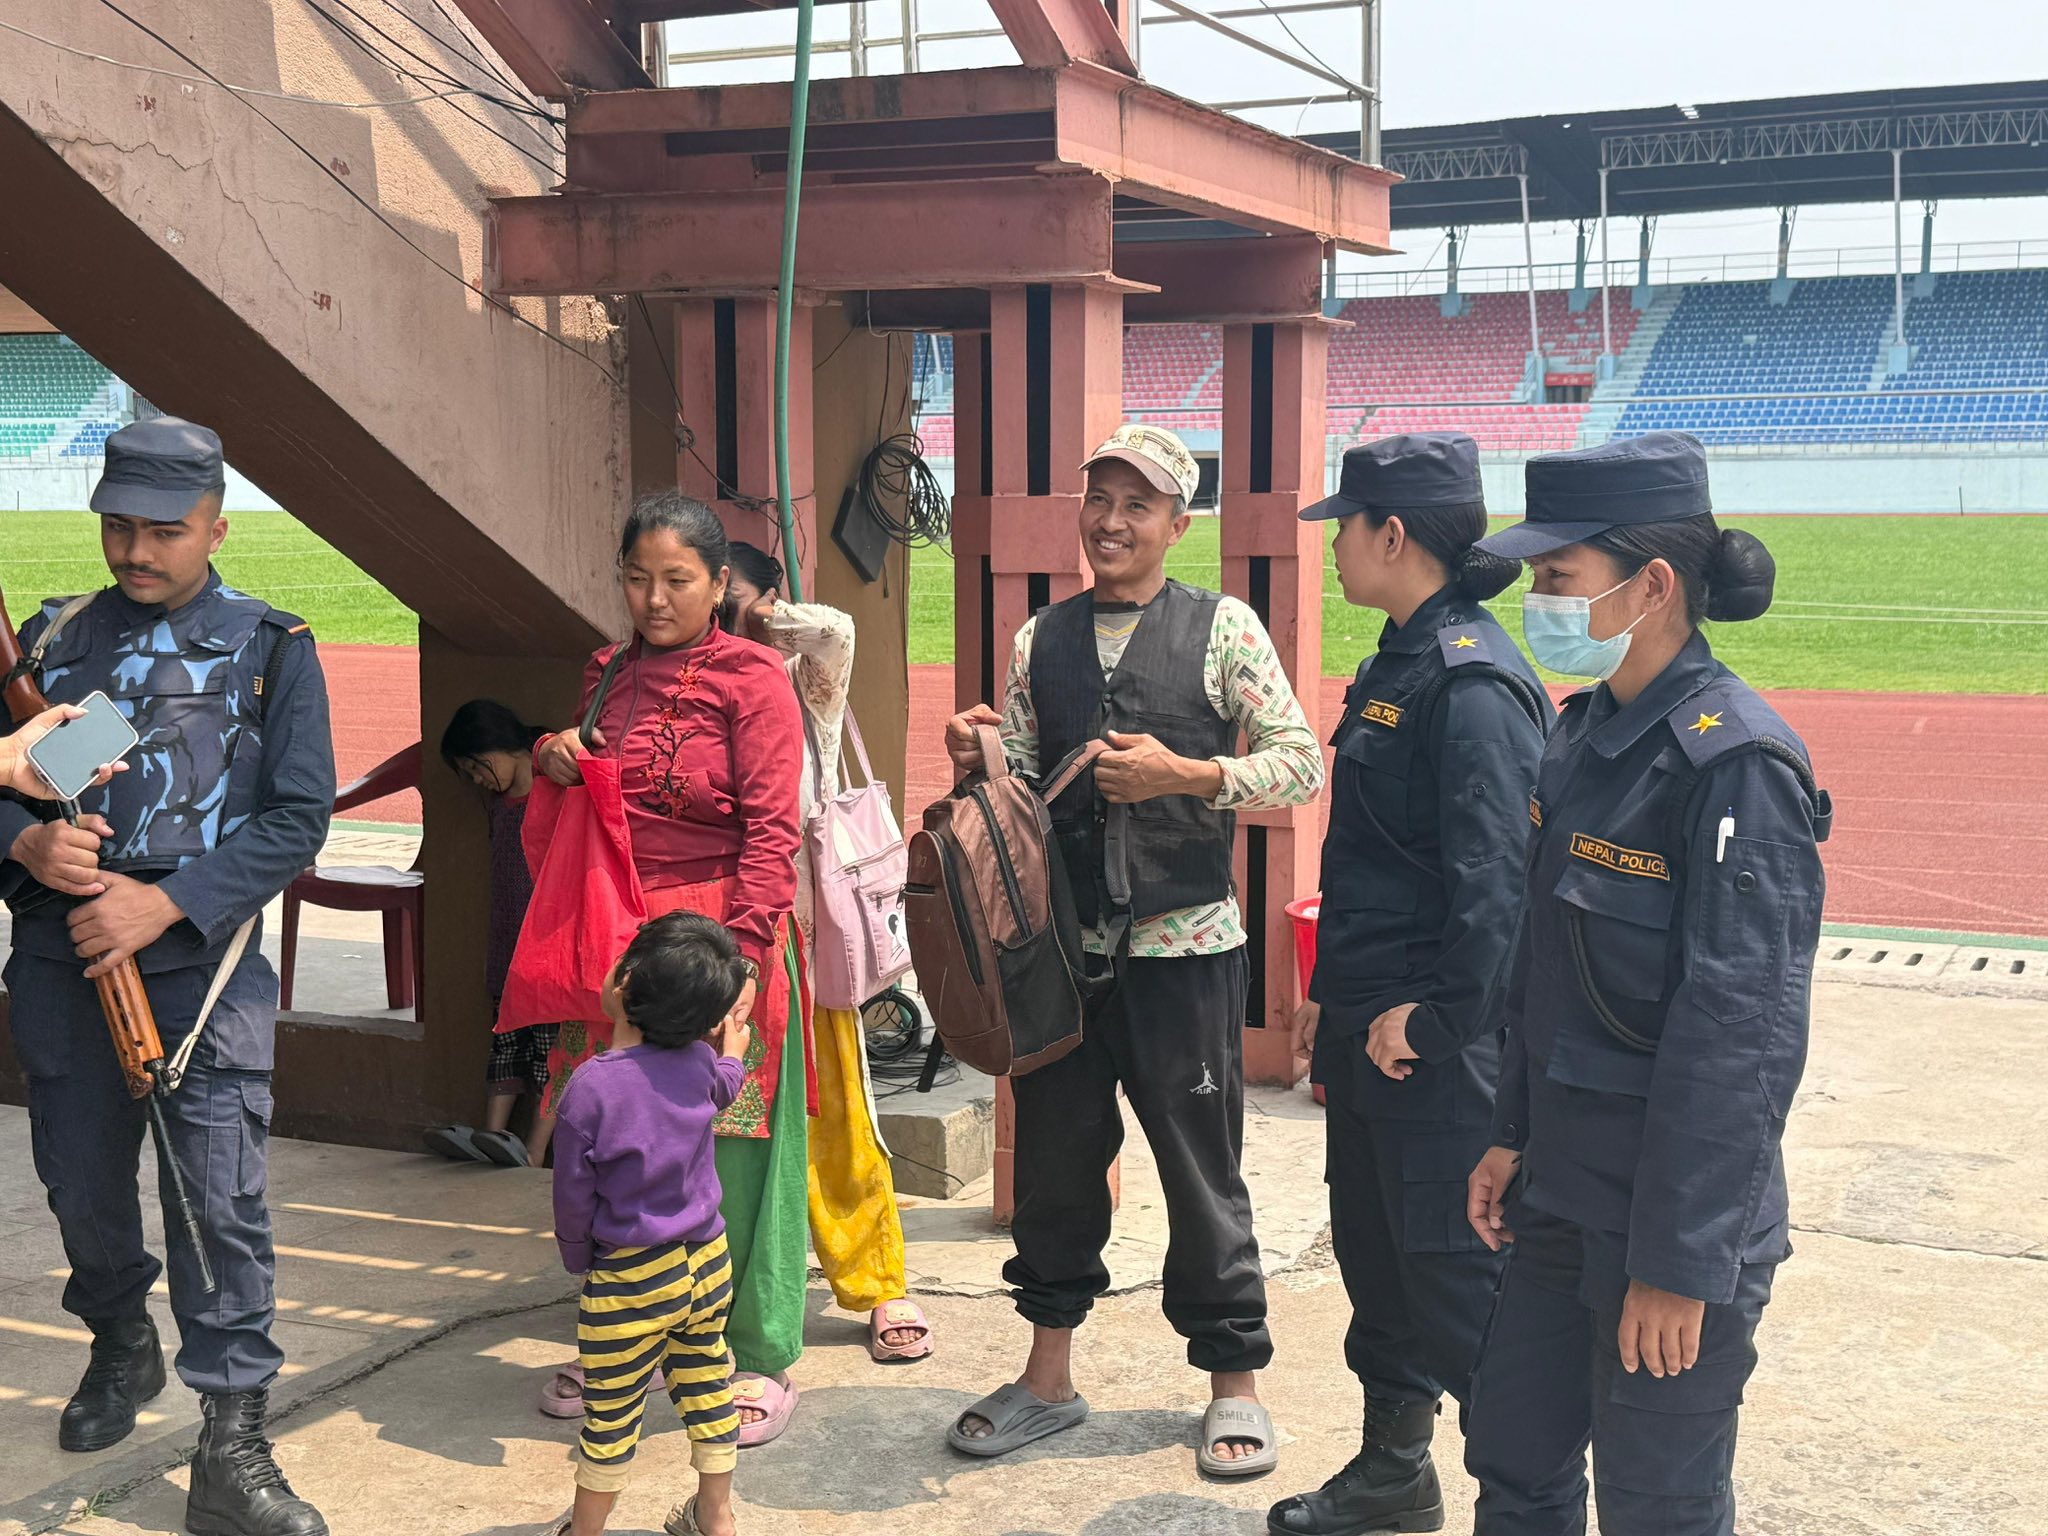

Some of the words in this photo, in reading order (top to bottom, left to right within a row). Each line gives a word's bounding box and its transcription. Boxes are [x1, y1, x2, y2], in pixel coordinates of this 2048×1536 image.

[1577, 839, 1616, 864] NEPAL
[1619, 854, 1666, 874] POLICE
[1216, 1410, 1255, 1424] SMILE
